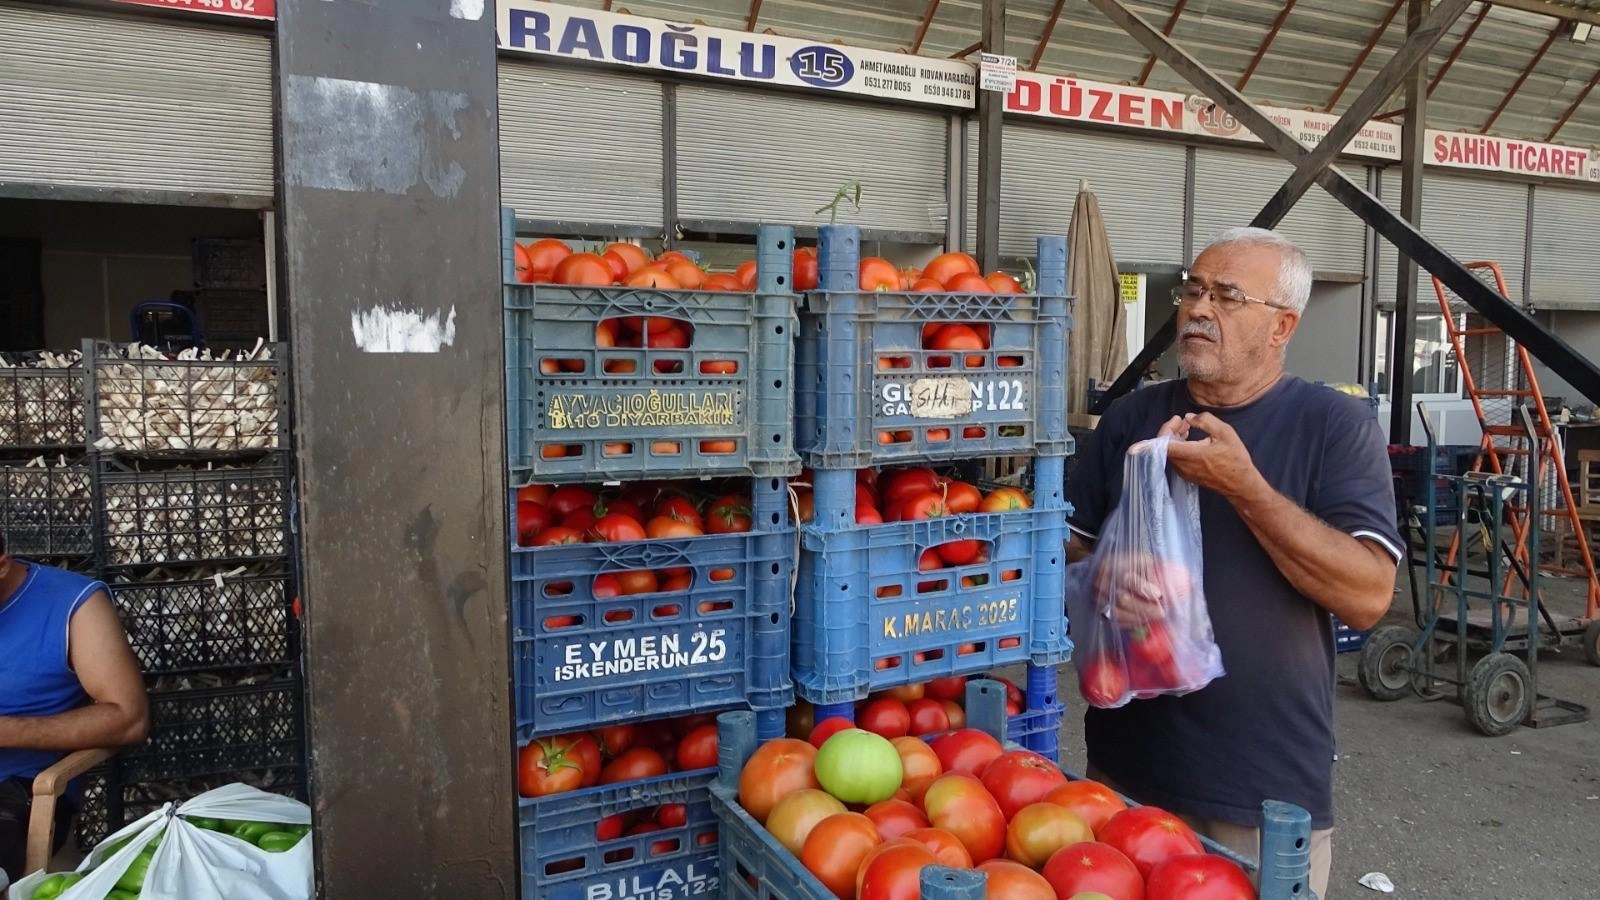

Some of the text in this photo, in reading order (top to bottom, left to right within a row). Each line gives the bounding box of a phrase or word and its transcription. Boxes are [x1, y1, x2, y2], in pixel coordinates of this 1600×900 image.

[495, 8, 845, 82] RAOĞLU 15
[860, 60, 882, 73] AHMET
[864, 76, 881, 89] 0531
[882, 79, 893, 90] 277
[1008, 78, 1238, 131] DÜZEN 16
[986, 380, 1024, 411] 122
[978, 598, 1018, 626] 2025
[565, 629, 726, 665] EYMEN 25
[587, 864, 707, 900] BILAL
